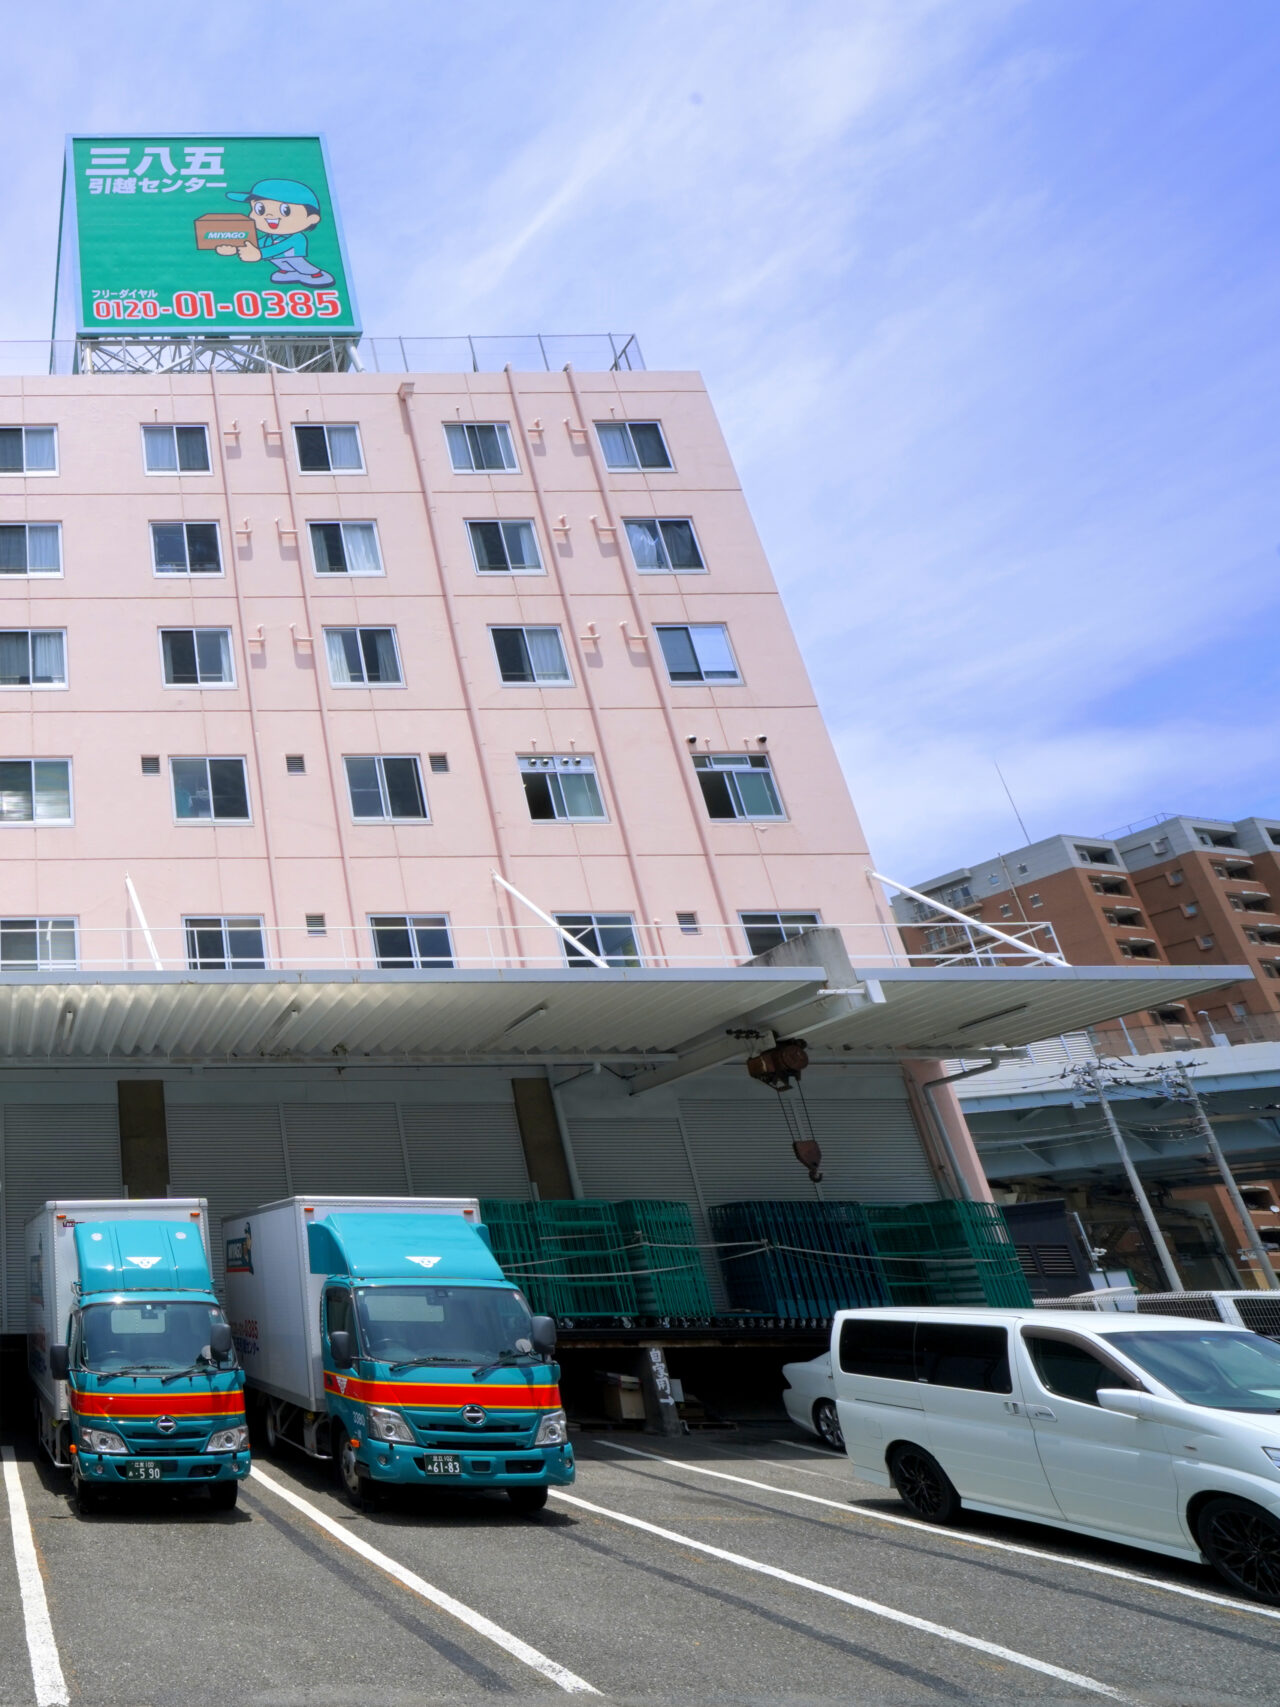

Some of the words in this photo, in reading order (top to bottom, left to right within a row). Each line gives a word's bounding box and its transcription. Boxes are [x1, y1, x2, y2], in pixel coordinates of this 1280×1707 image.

[85, 147, 225, 176] 三八五
[88, 177, 227, 194] 引越センター
[207, 231, 246, 239] MIYAGO
[91, 289, 158, 299] フリーダイヤル
[93, 290, 341, 319] 0120-01-0385
[433, 1461, 460, 1473] 61-83
